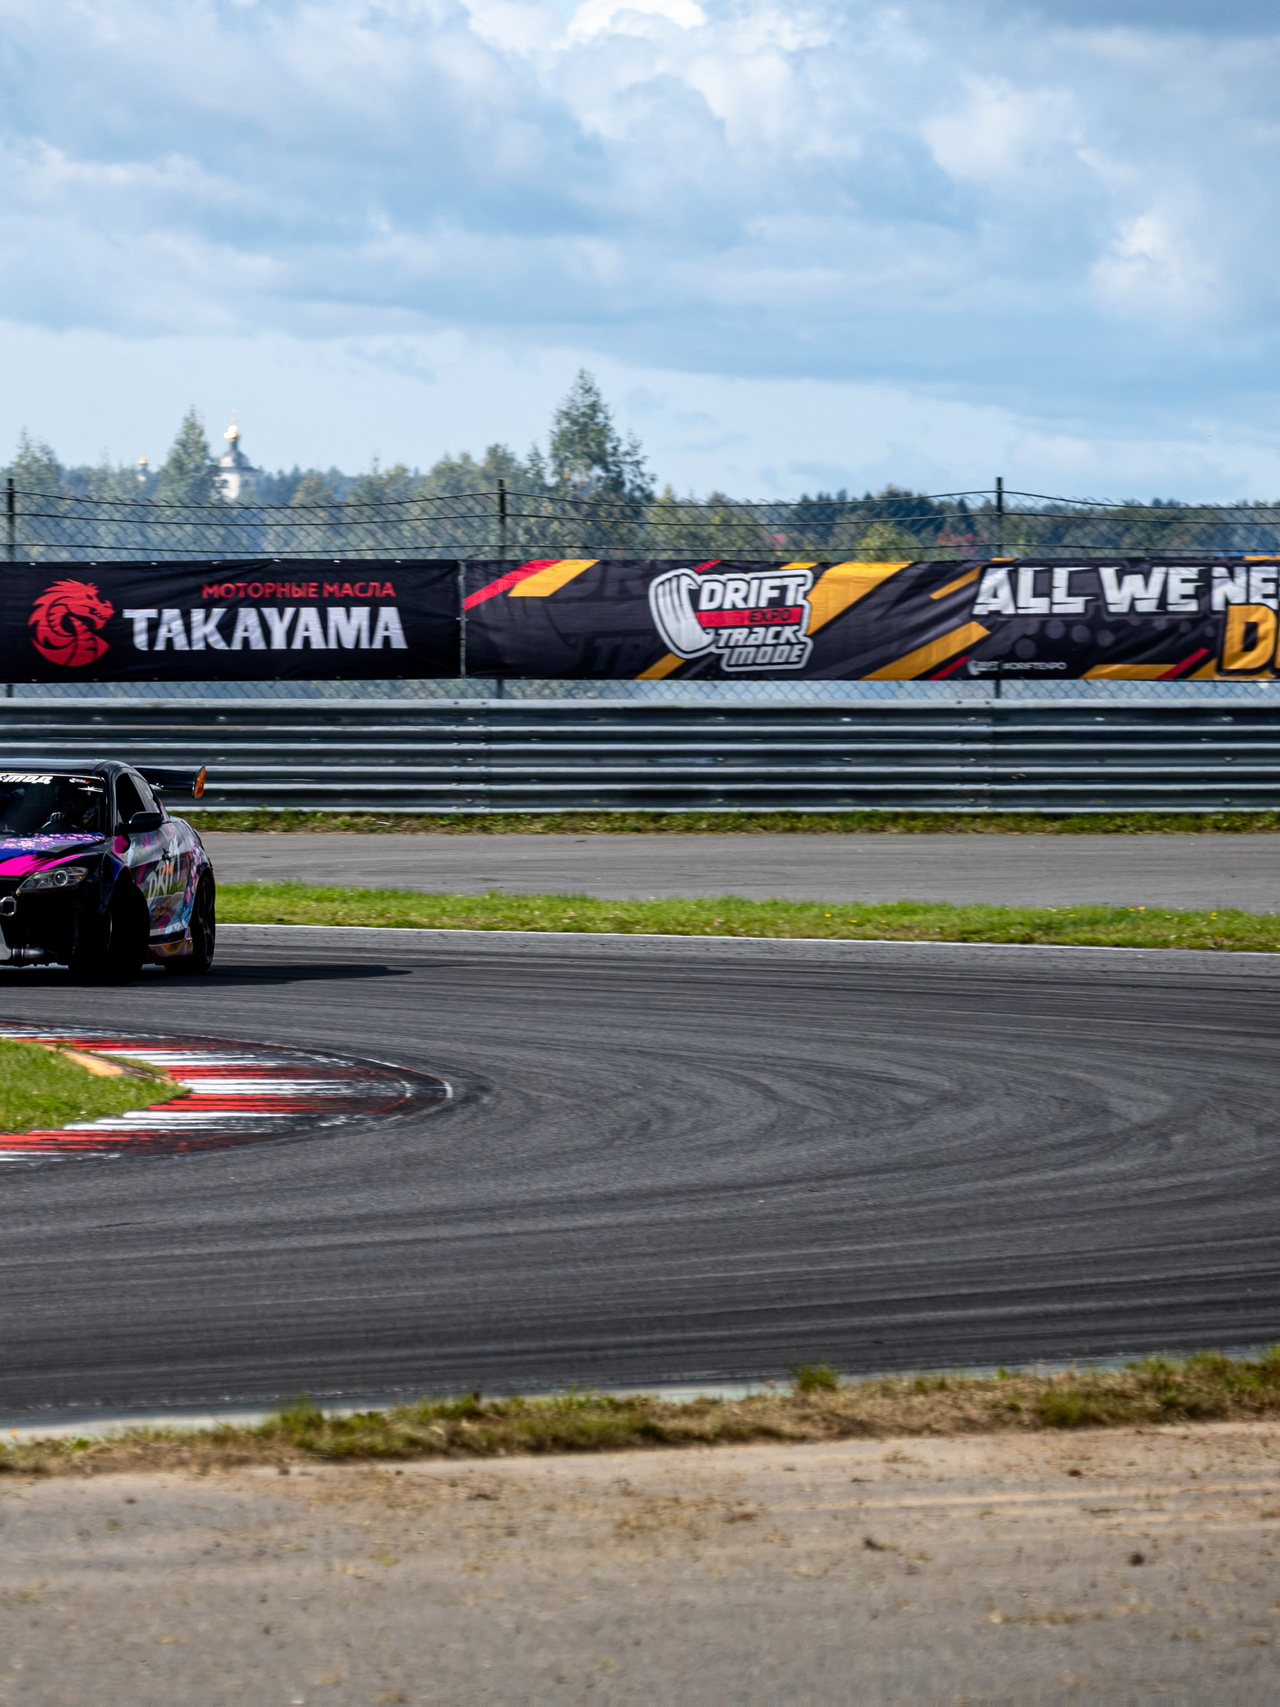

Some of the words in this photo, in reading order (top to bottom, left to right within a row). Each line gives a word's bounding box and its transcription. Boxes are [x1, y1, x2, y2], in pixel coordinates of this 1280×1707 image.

[202, 582, 319, 599] МОТОРНЫЕ
[322, 582, 396, 598] МАСЛА
[698, 577, 806, 610] DRIFT
[972, 567, 1096, 615] ALL
[1099, 566, 1208, 613] WE
[122, 606, 409, 651] TAKAYAMA
[749, 609, 792, 623] EXPO
